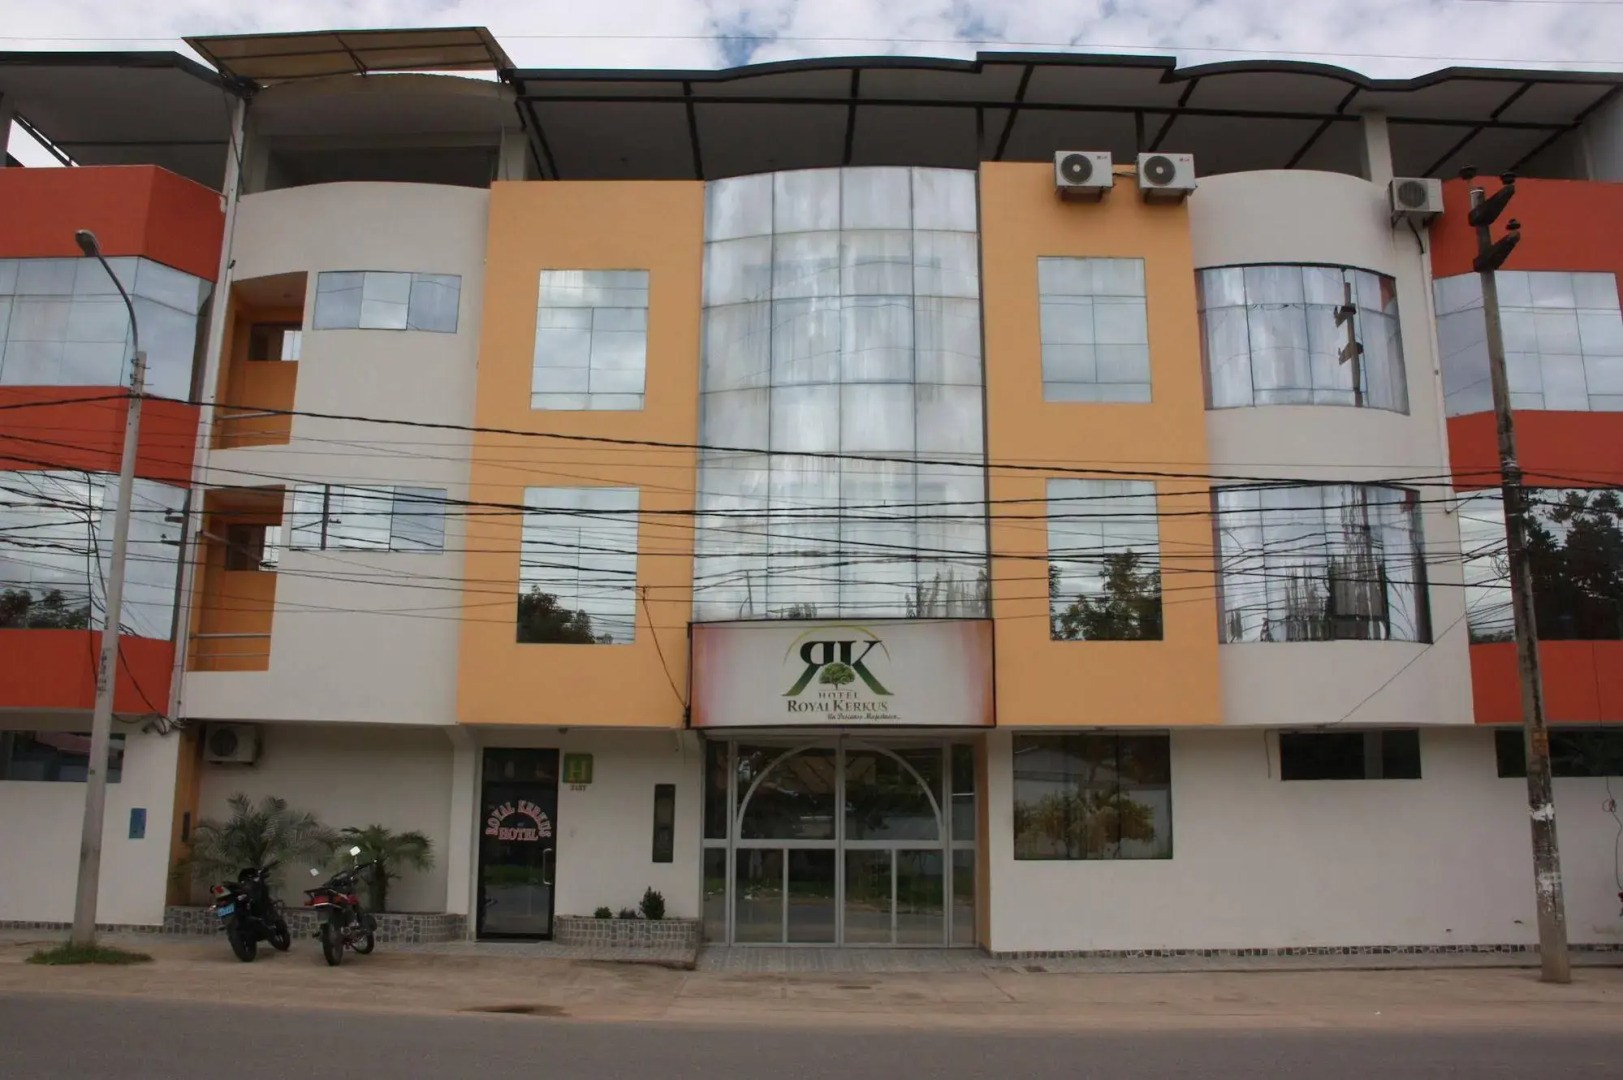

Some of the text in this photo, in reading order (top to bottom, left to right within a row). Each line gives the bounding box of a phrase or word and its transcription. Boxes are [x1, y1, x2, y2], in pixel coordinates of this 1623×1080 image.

[818, 691, 858, 699] HOTEL
[485, 800, 552, 838] ROYAL KERKUS
[498, 827, 539, 841] HOTEL
